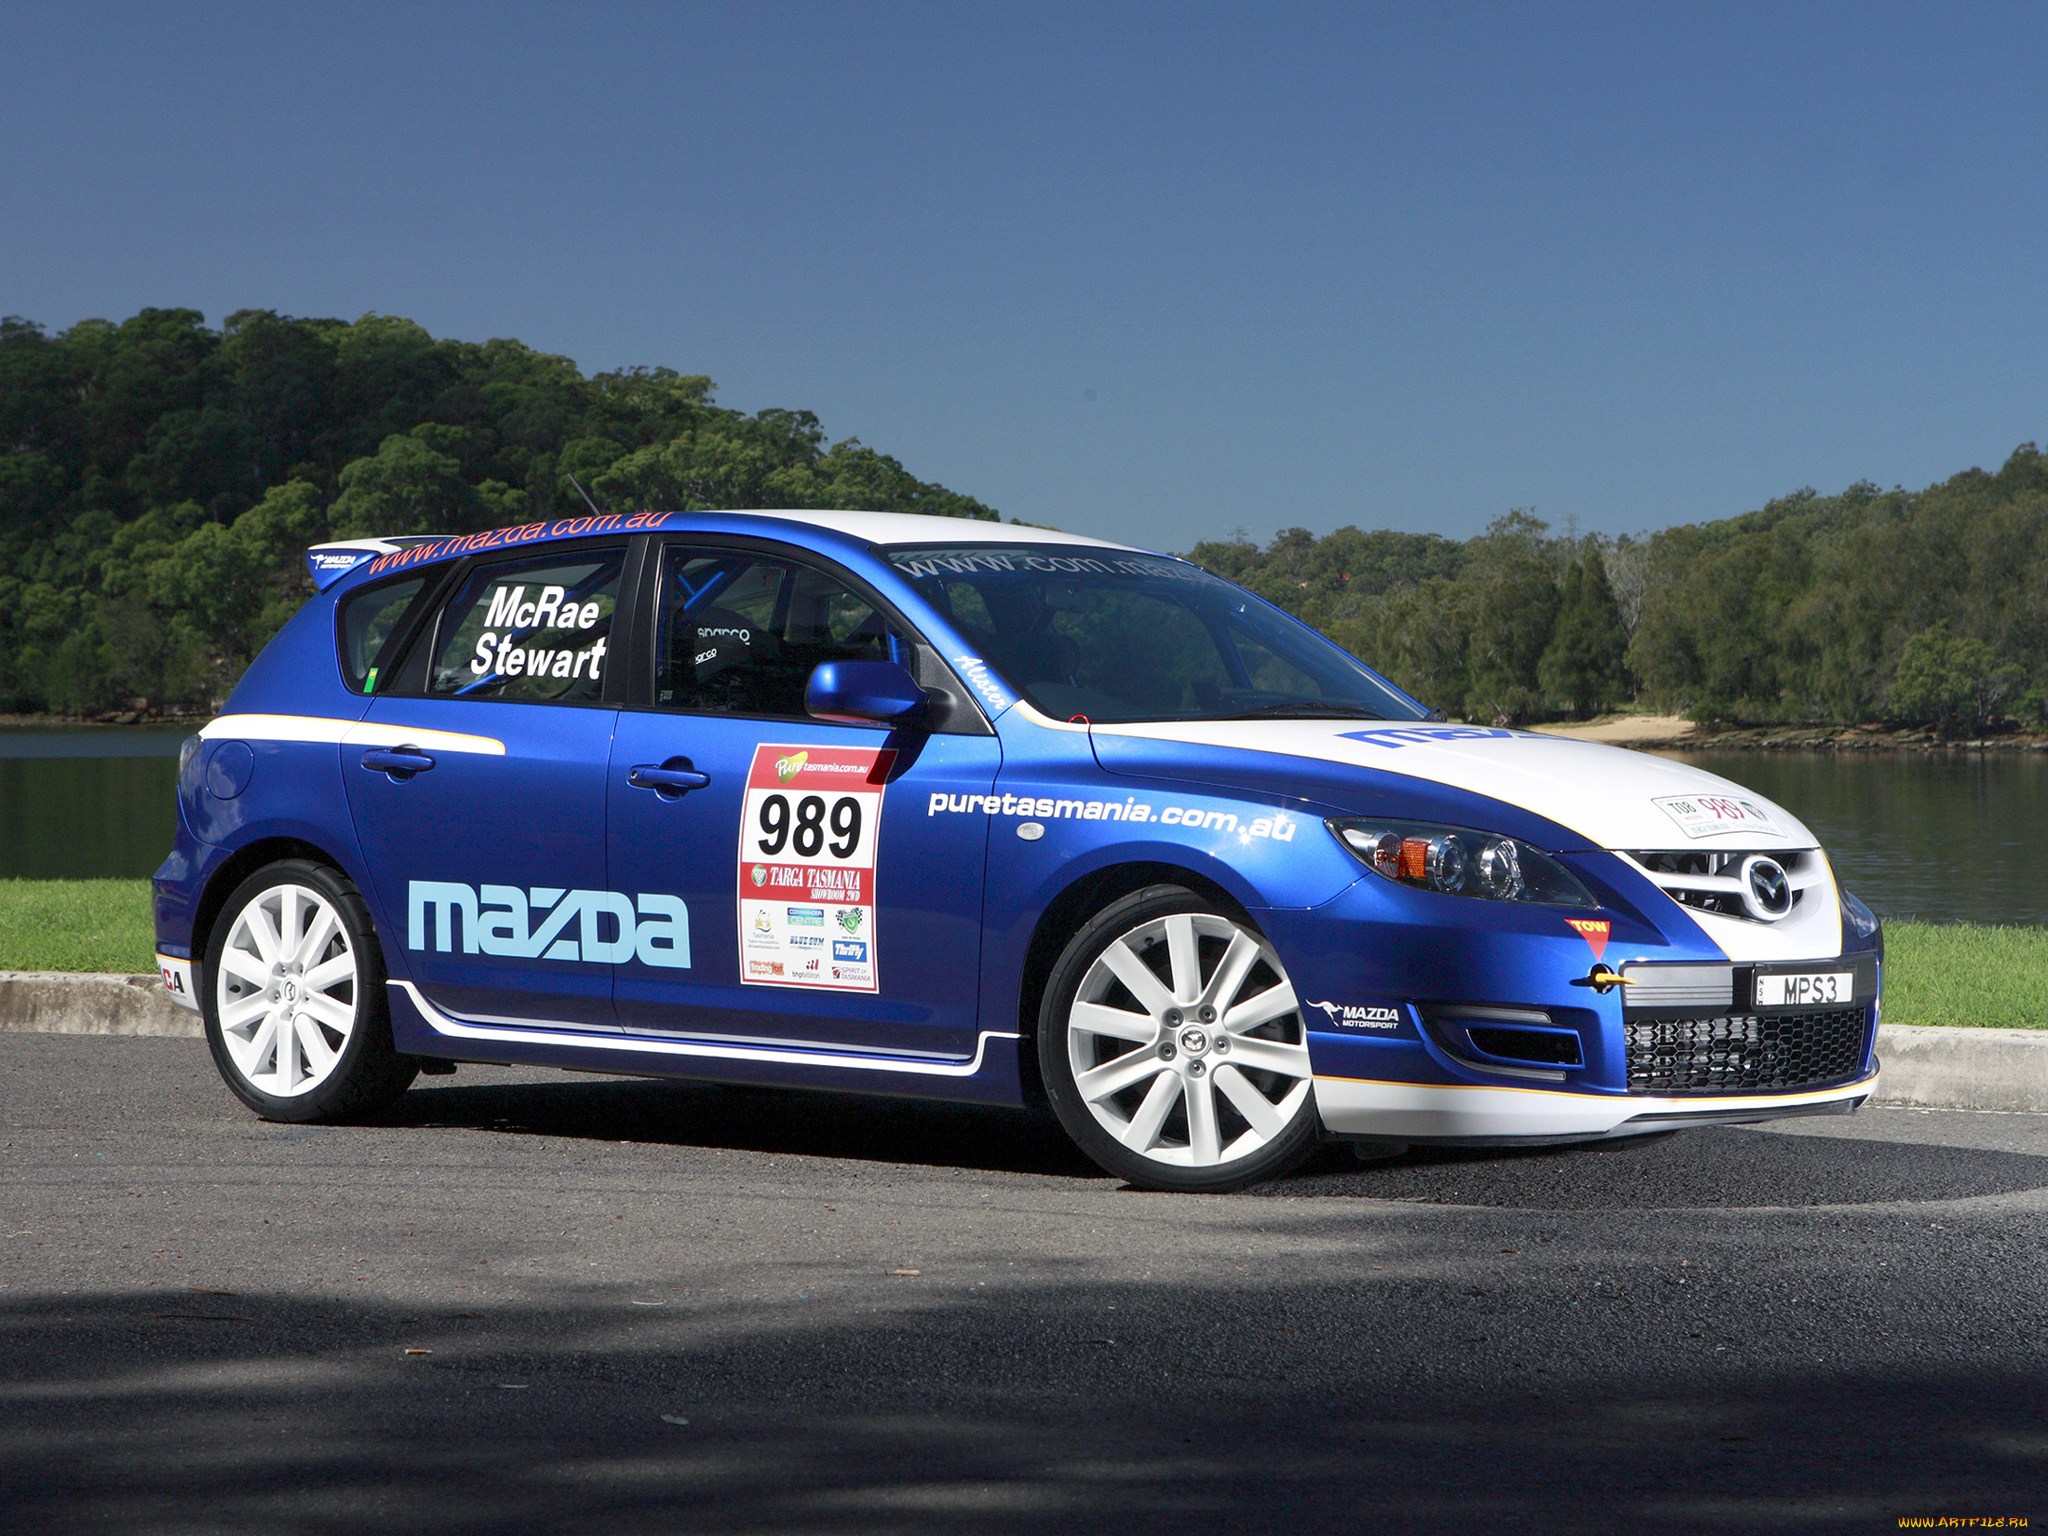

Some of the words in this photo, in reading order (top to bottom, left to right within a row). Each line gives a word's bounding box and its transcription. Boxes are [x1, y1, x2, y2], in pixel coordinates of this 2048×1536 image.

[369, 512, 673, 575] www.mazda.com.au
[484, 586, 600, 629] McRae
[470, 632, 607, 680] Stewart
[953, 655, 1006, 710] Alister
[758, 794, 862, 859] 989
[928, 792, 1296, 842] puretasmania.com.au
[1697, 797, 1745, 819] 989
[770, 866, 804, 887] TARGA
[806, 868, 861, 890] TASMANIA
[409, 880, 692, 969] mazda
[1570, 920, 1608, 932] TOW
[1784, 976, 1837, 1004] MPS3
[1341, 1019, 1399, 1030] MOTORSPORT
[1342, 1006, 1399, 1022] MAZDA
